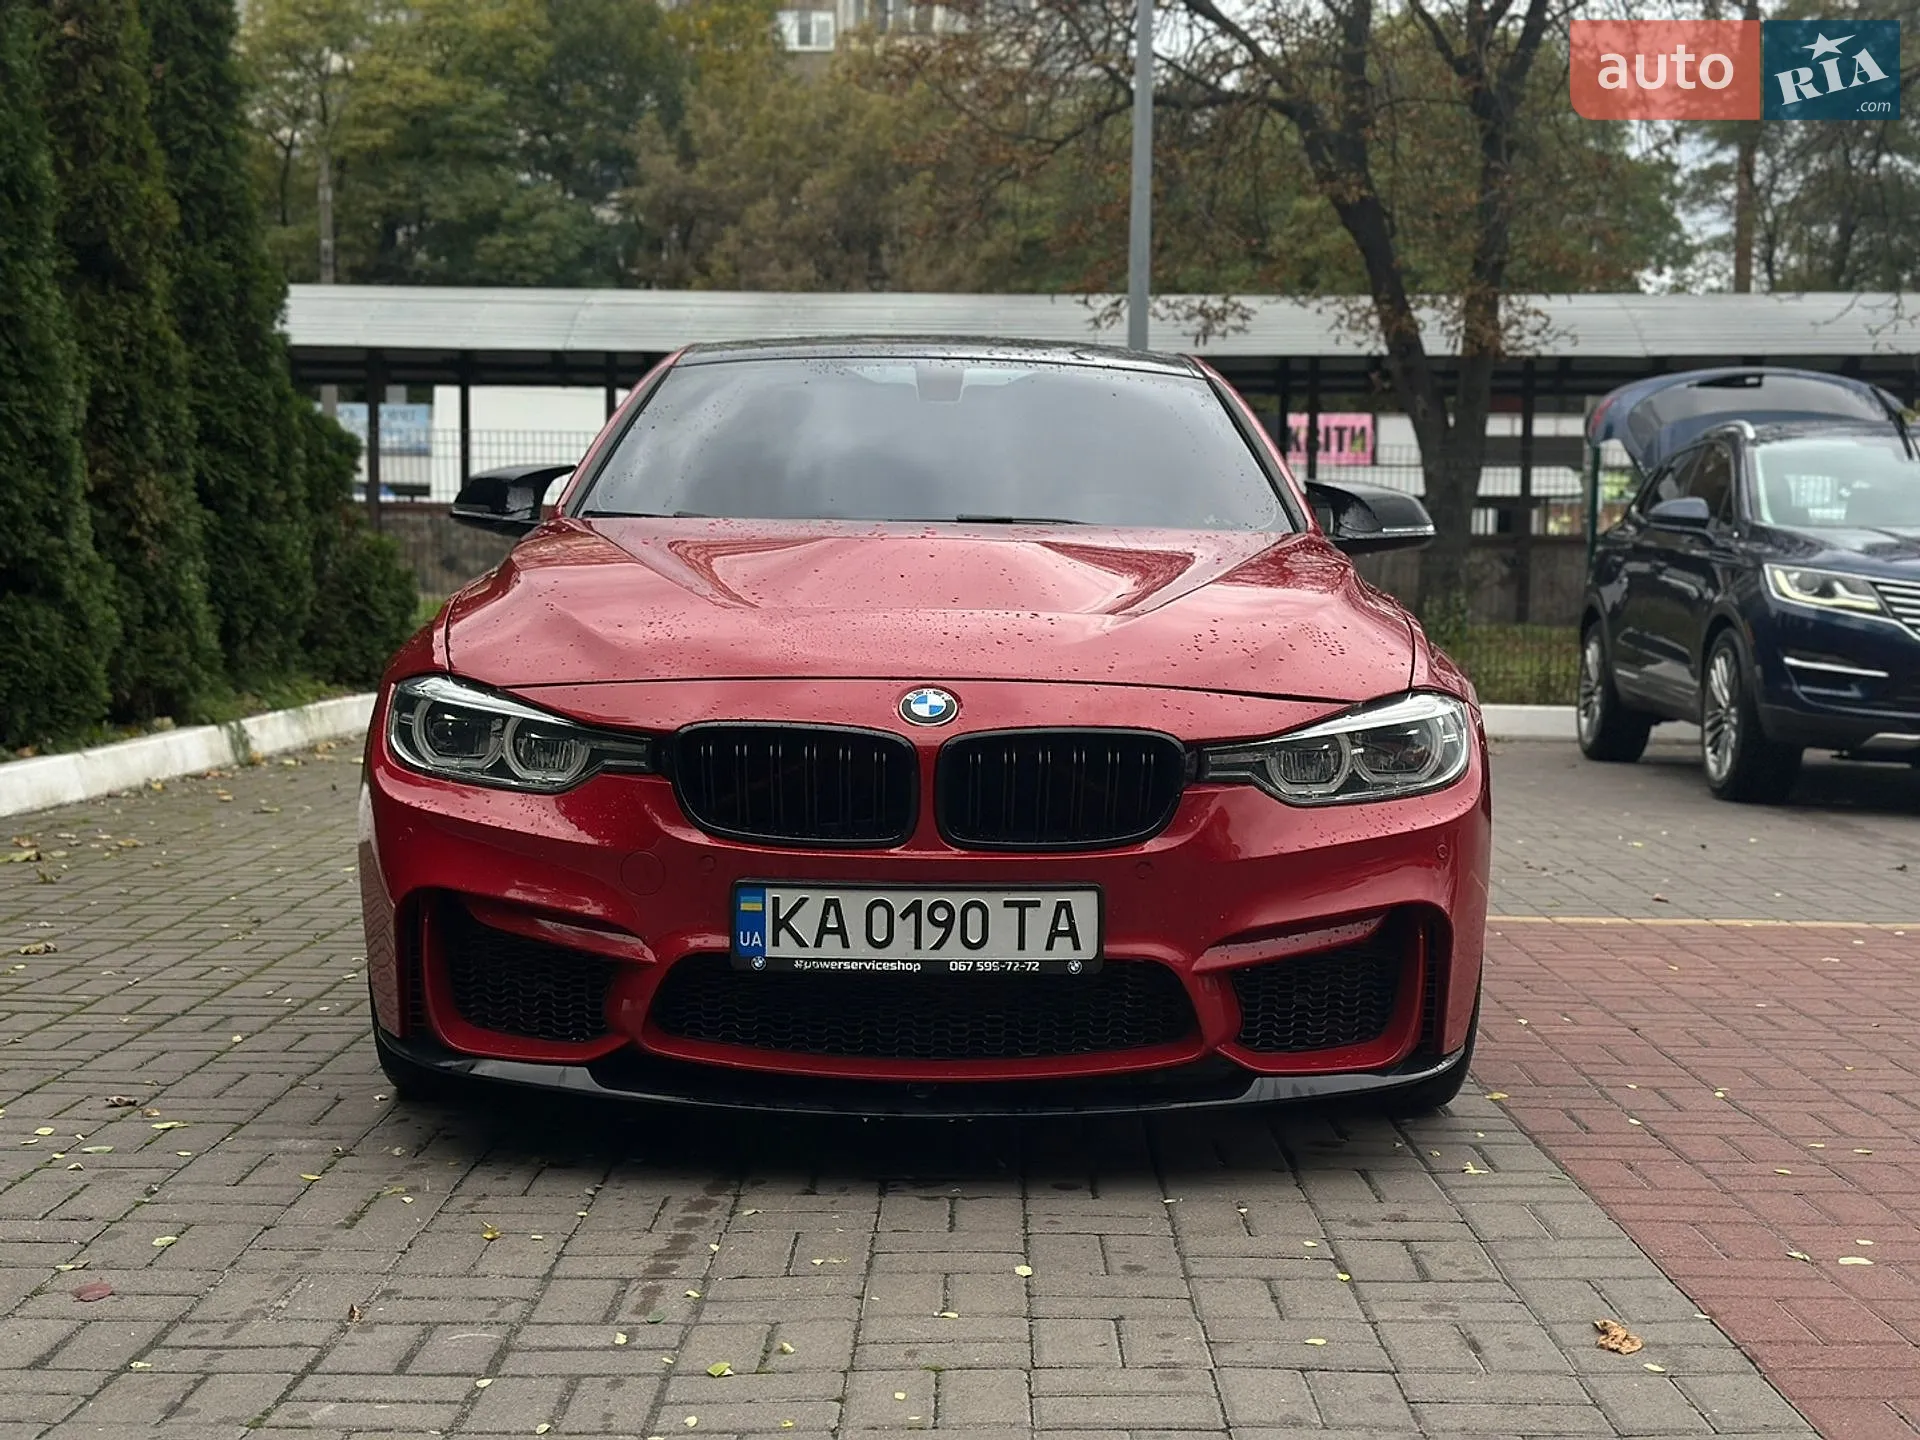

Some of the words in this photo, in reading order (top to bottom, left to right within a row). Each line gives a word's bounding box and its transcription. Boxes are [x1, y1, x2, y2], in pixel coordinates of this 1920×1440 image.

[771, 895, 850, 949] KA
[865, 898, 989, 950] 0190
[1002, 899, 1082, 951] TA
[739, 931, 763, 947] UA
[949, 961, 974, 972] 067
